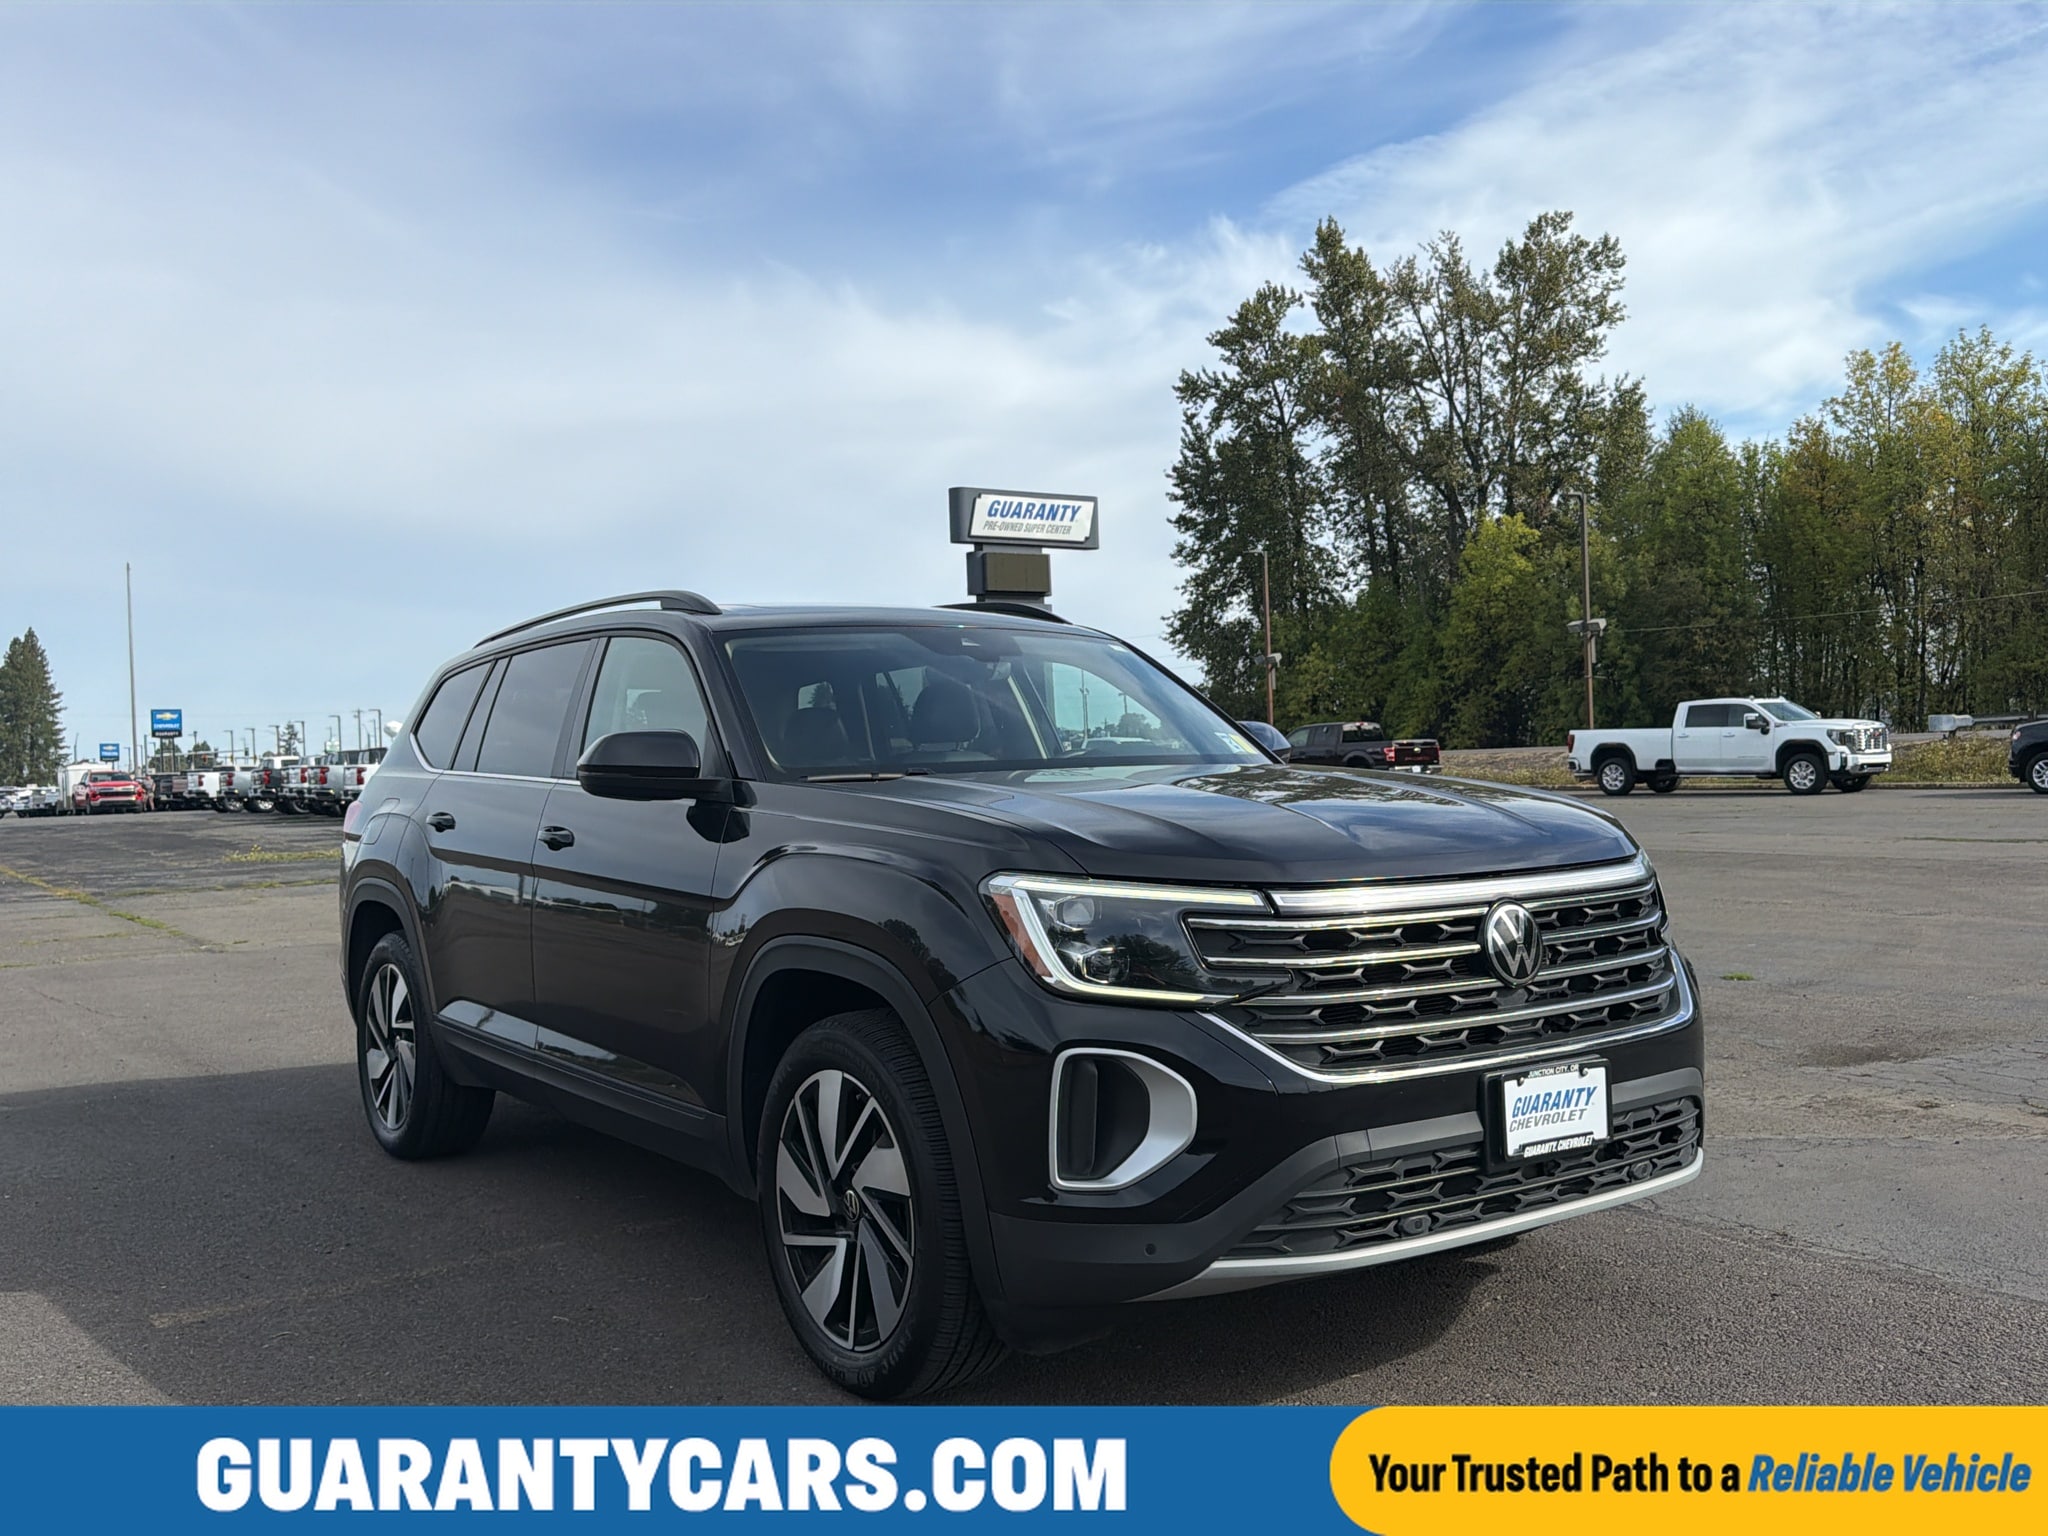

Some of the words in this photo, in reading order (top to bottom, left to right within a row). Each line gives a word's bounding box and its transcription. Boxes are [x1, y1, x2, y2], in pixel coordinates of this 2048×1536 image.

[987, 500, 1082, 522] GUARANTY
[982, 520, 1024, 532] PRE-OWNED
[1024, 522, 1046, 534] SUPER
[1046, 524, 1073, 535] CENTER
[1511, 1086, 1598, 1118] GUARANTY
[1509, 1108, 1588, 1133] CHEVROLET
[1557, 1134, 1593, 1151] CHEVROLET
